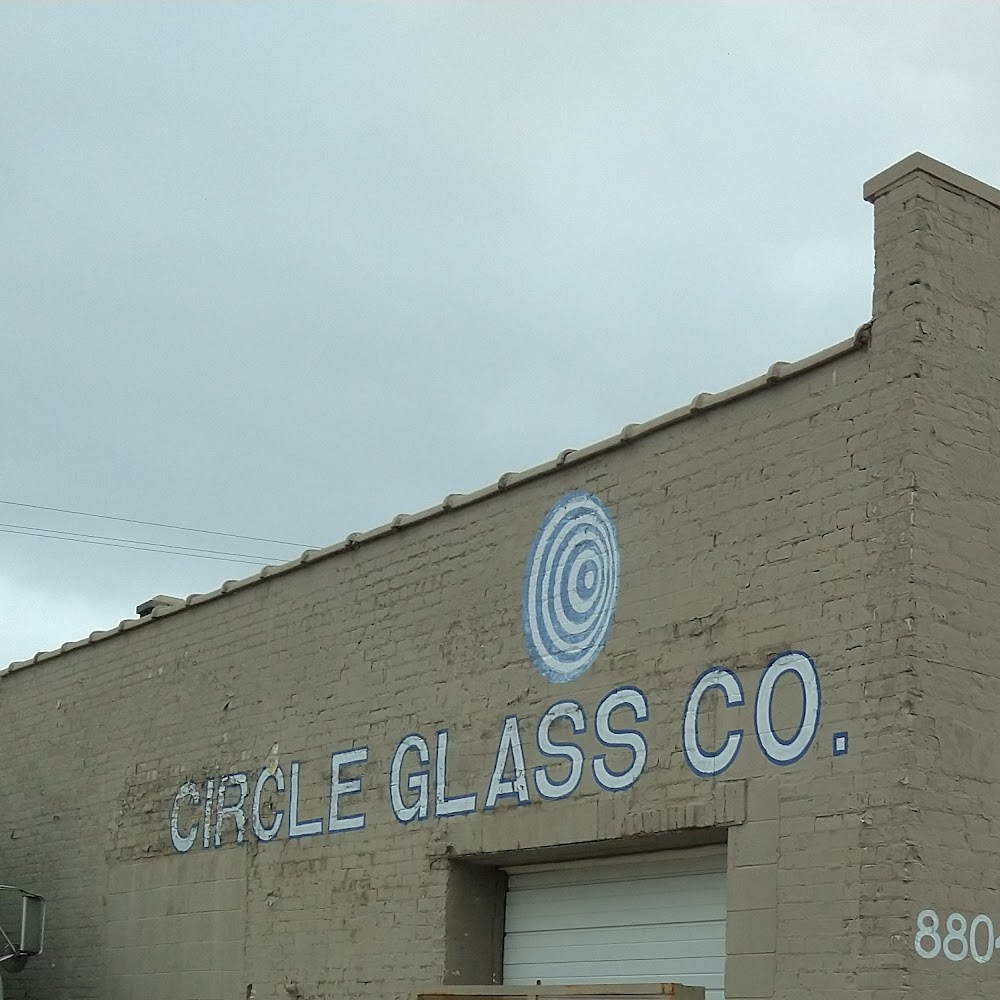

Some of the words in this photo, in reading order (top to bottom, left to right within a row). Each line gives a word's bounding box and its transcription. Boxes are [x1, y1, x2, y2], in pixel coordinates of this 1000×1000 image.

[170, 747, 368, 853] CIRCLE
[389, 685, 649, 824] GLASS
[682, 650, 848, 777] CO.
